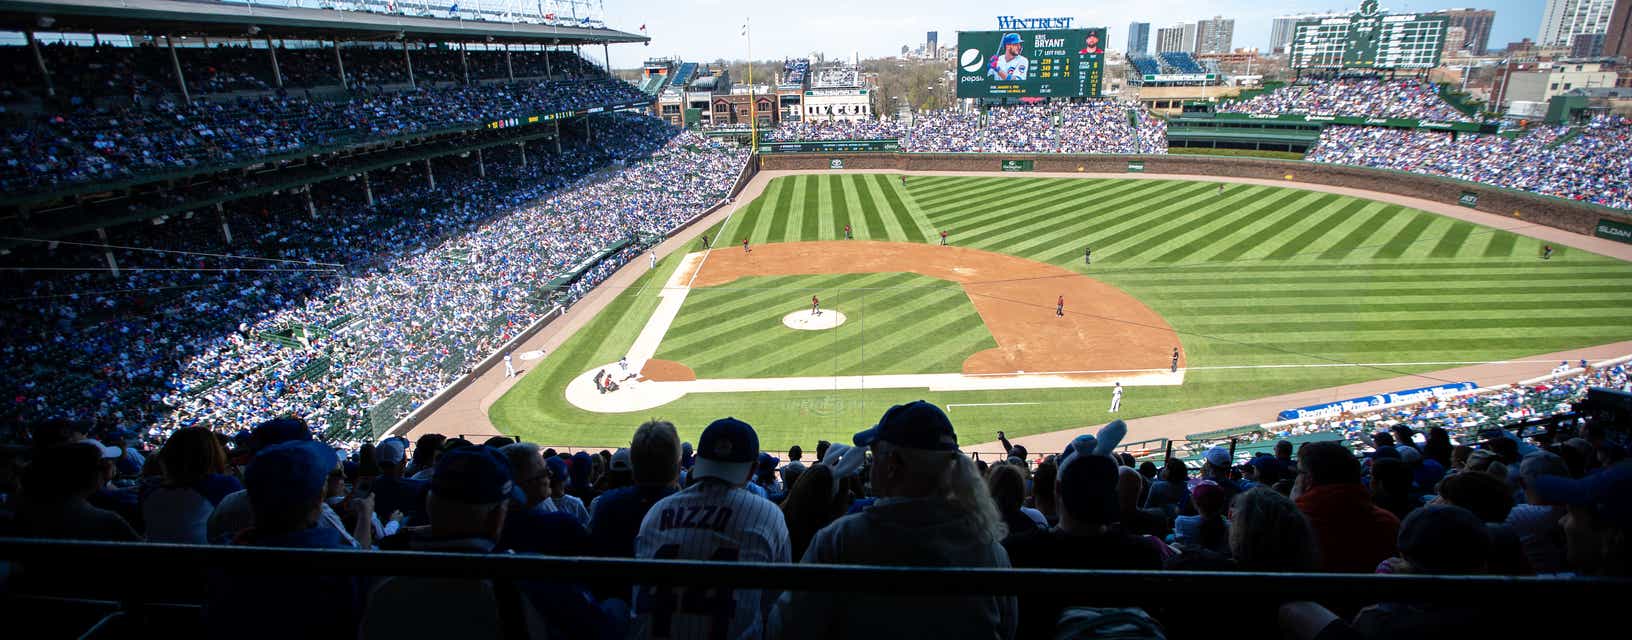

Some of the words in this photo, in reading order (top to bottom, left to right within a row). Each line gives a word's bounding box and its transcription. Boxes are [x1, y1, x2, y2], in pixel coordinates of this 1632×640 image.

[997, 16, 1073, 29] WINTRUST
[1034, 39, 1065, 48] BRYANT
[961, 75, 982, 84] pepsi
[1598, 225, 1632, 238] SLOAN
[1299, 404, 1342, 419] Reynolds
[660, 505, 734, 532] RIZZO
